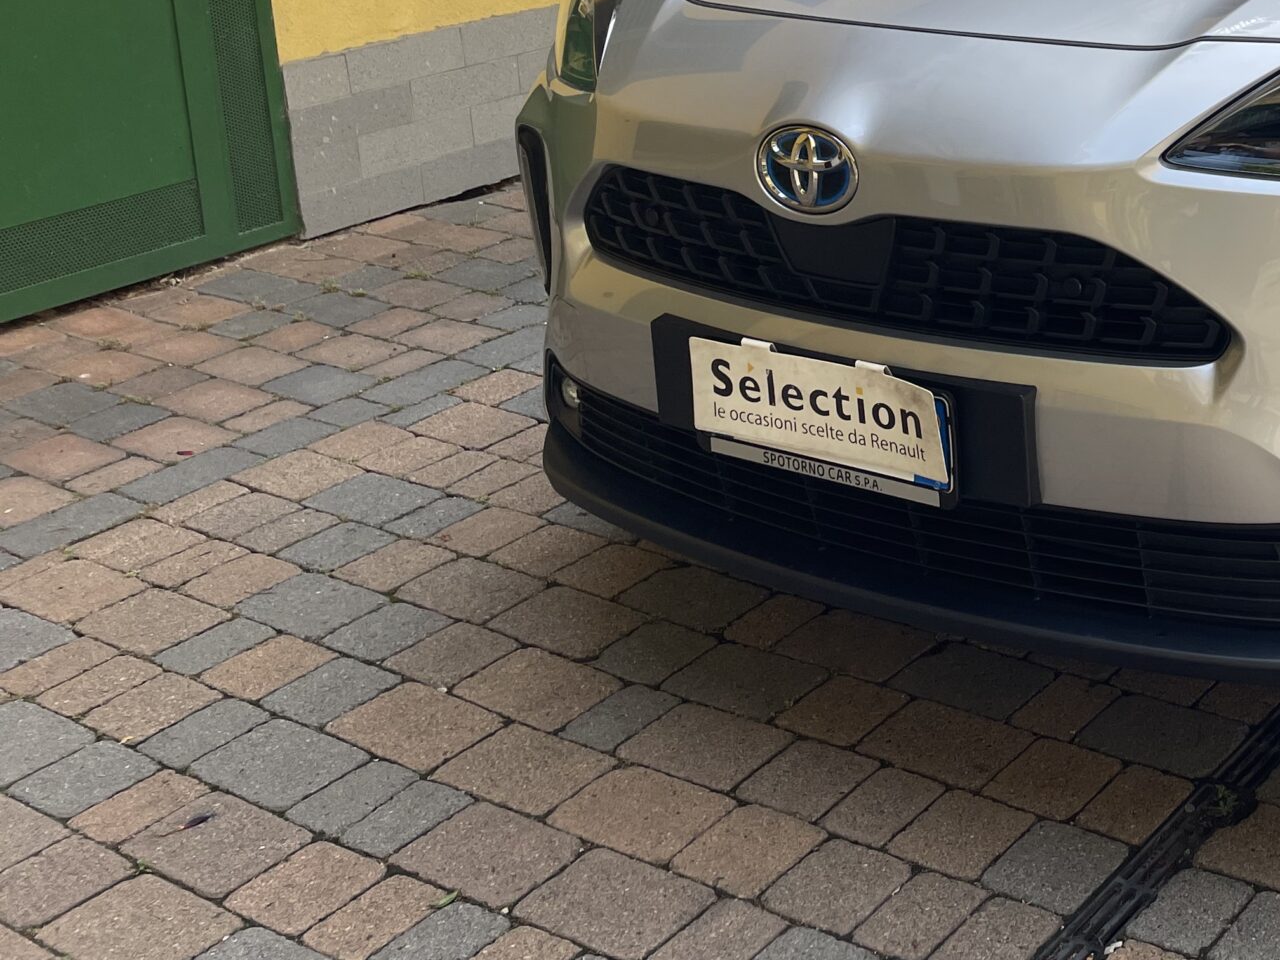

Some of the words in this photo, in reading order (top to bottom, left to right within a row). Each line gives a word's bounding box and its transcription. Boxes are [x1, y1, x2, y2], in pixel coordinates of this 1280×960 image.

[713, 400, 726, 419] le
[729, 408, 798, 433] occasioni
[801, 422, 844, 442] scelte
[848, 428, 867, 447] da
[870, 432, 926, 462] Renault
[763, 451, 825, 477] SPOTORNO
[828, 466, 852, 485] CAR
